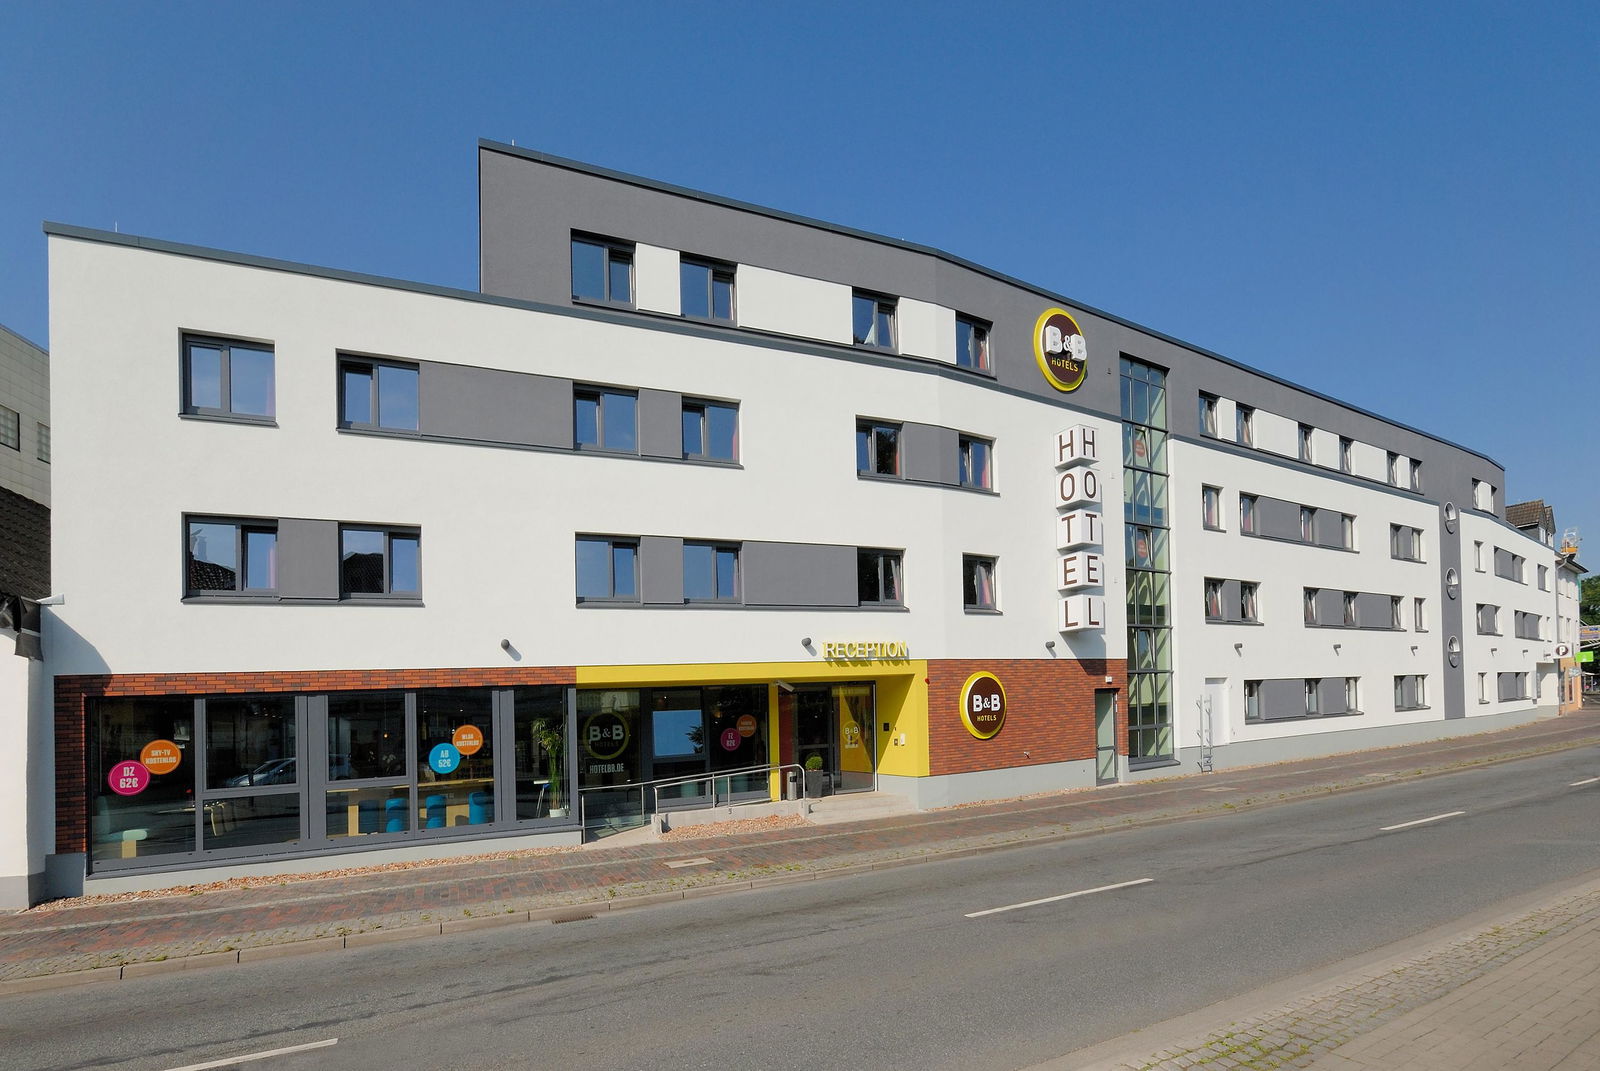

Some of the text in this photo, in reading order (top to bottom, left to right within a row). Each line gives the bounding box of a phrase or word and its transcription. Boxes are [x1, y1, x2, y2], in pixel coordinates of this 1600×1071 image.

[1045, 326, 1087, 361] B&B
[1051, 357, 1079, 372] HOTELS
[1059, 429, 1078, 627] HOTEL
[1082, 428, 1100, 626] HOTEL
[823, 641, 908, 659] RECEPTION
[973, 694, 1001, 712] B&B
[976, 714, 997, 722] HOTELS
[589, 724, 624, 741] B&B
[123, 766, 135, 776] DZ
[589, 762, 625, 774] HOTELBB.DE
[120, 777, 138, 788] 62€
